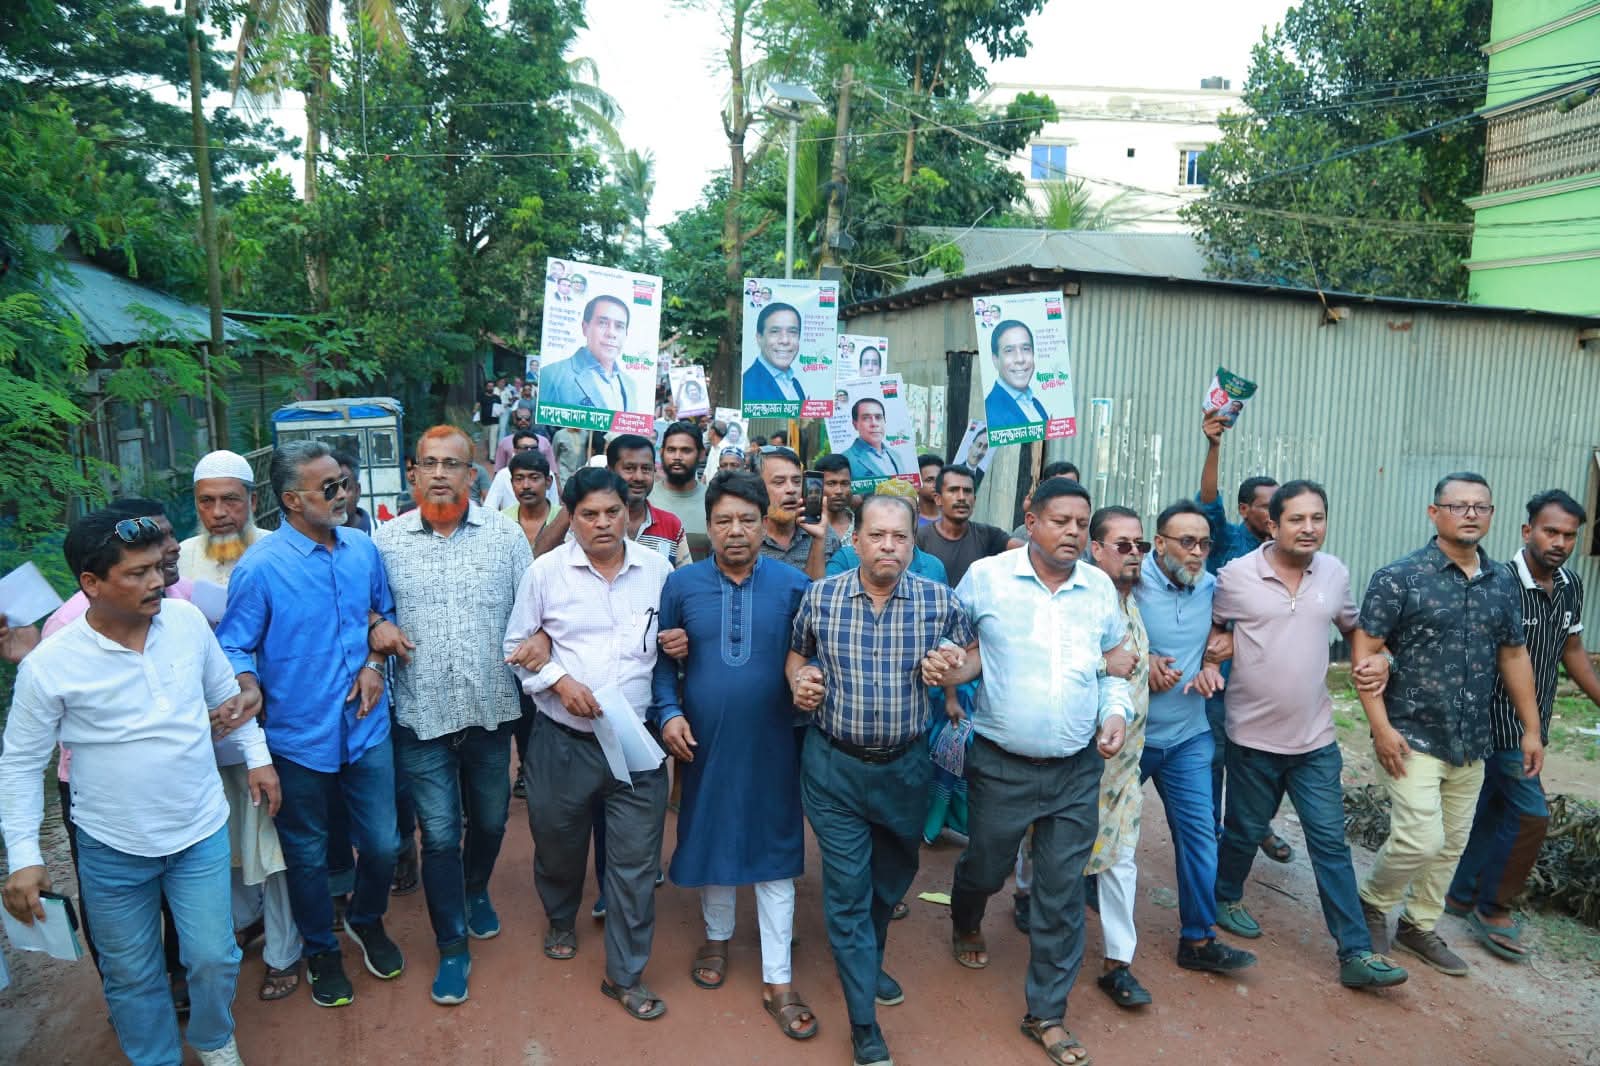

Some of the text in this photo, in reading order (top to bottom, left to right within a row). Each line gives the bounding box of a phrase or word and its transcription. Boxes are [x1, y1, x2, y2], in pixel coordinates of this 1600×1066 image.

[539, 405, 587, 424] মাসুদুজ্জামান
[589, 411, 611, 429] মাসুদ
[990, 426, 1027, 444] মাসুদুজ্জামান
[1028, 424, 1044, 439] মাসুদ
